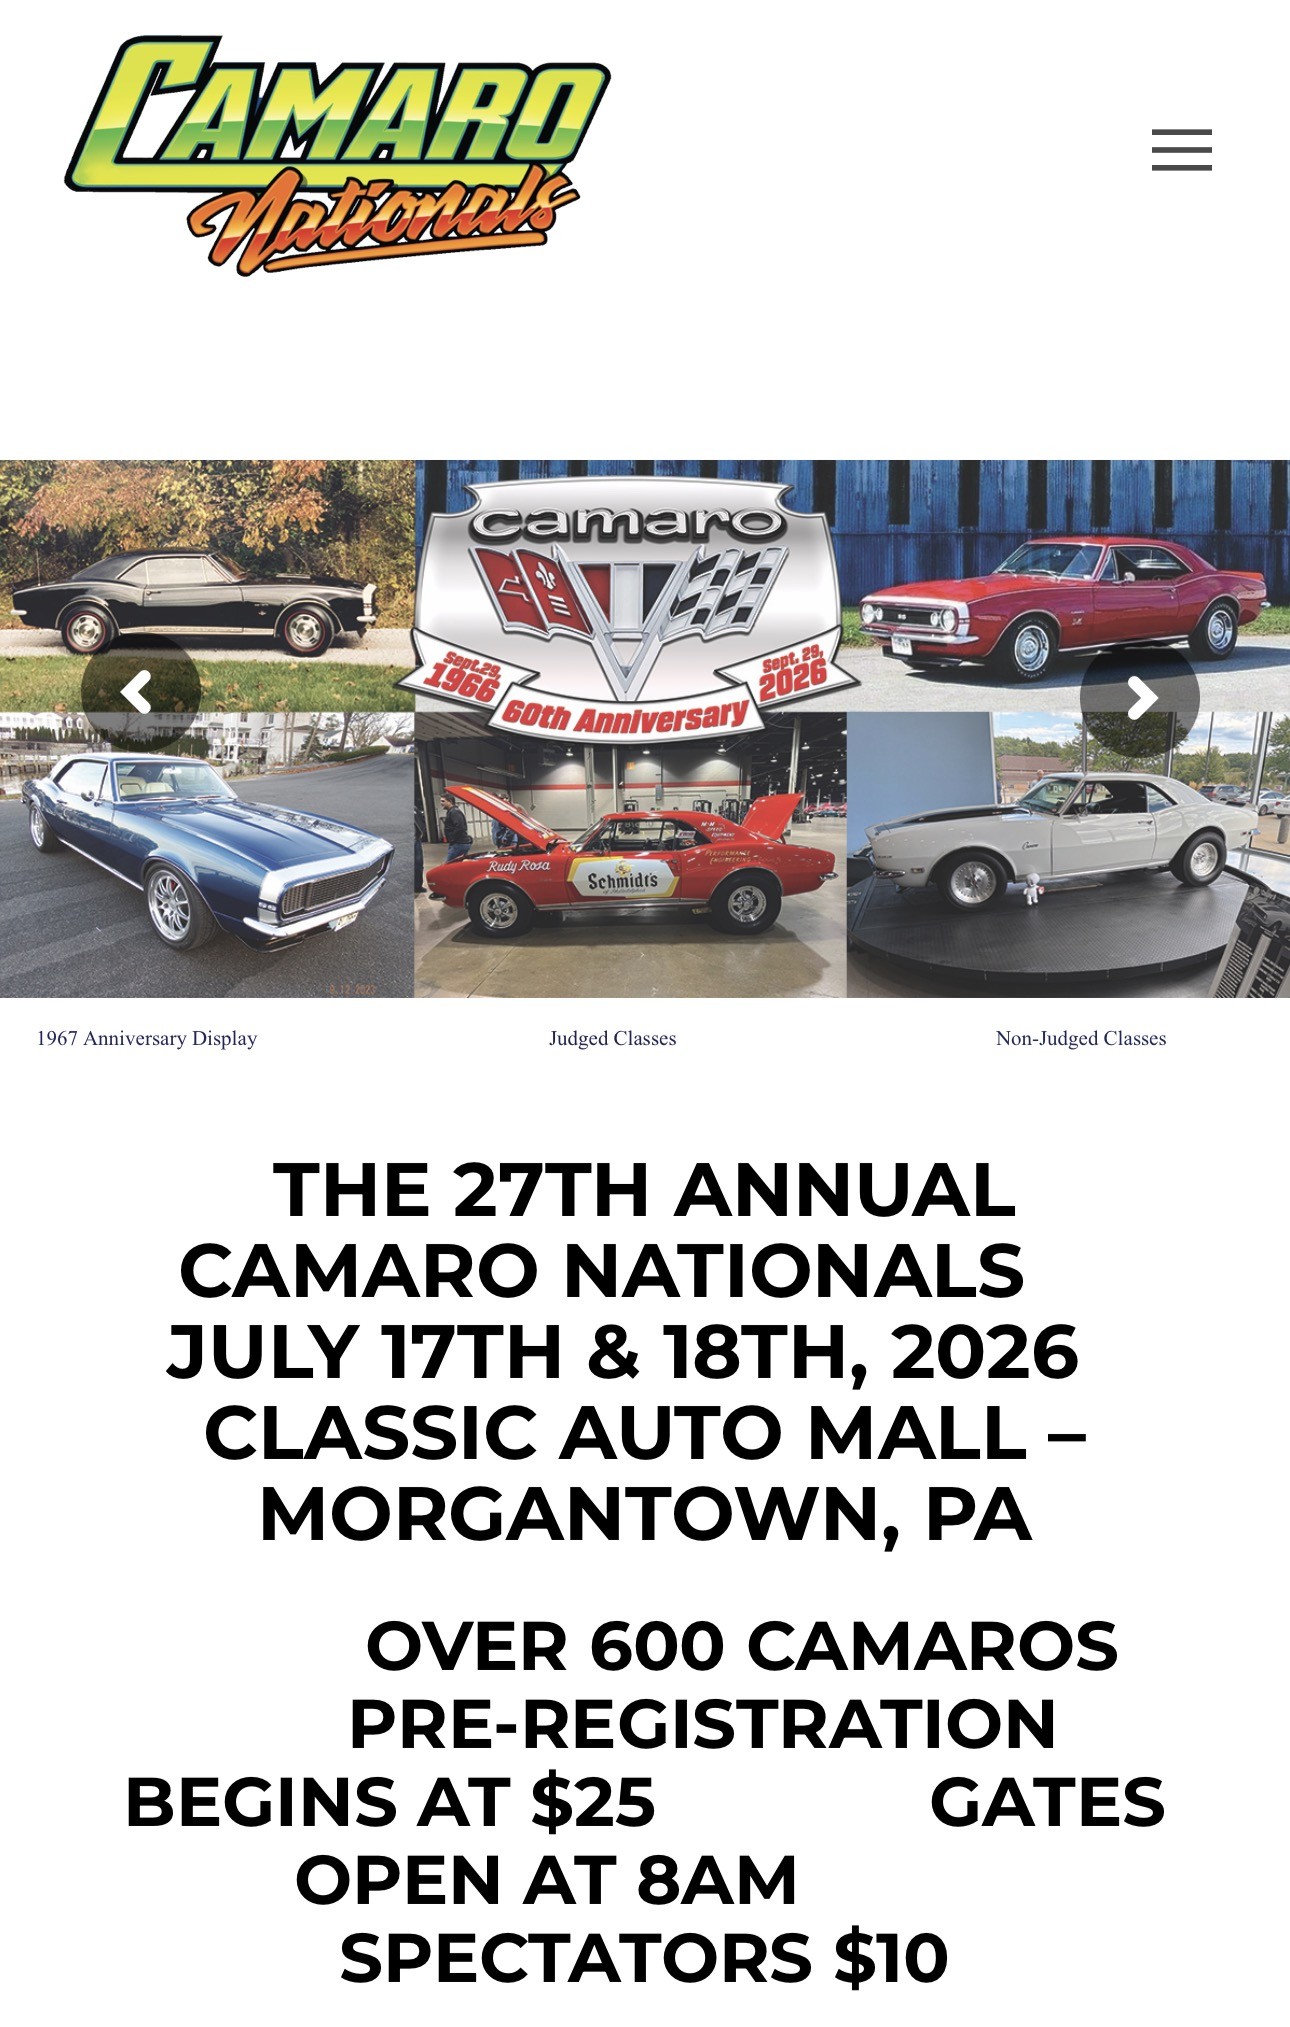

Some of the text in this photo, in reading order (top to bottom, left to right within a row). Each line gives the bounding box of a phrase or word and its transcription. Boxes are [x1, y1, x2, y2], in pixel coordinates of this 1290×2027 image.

[64, 35, 612, 192] CAMARO
[186, 164, 581, 276] Nationals
[469, 506, 788, 544] camaro
[423, 662, 501, 703] 1966
[759, 657, 827, 703] 2026
[762, 643, 824, 674] Sept. 29,
[501, 699, 750, 734] 60th Anniversary
[486, 859, 551, 874] Rudy Rosa
[588, 871, 658, 890] Schmidt's
[38, 1029, 258, 1051] 1967 Anniversary Display
[549, 1029, 677, 1051] Judged Classes
[995, 1029, 1167, 1051] Non-Judged Classes
[272, 1161, 1016, 1218] THE 27TH ANNUAL
[180, 1242, 1024, 1299] CAMARO NATIONALS
[165, 1323, 1079, 1391] JULY 17TH & 18TH, 2026
[205, 1404, 537, 1461] CLASSIC
[557, 1404, 782, 1461] AUTO
[810, 1405, 1027, 1460] MALL
[262, 1485, 1034, 1553] MORGANTOWN, PA
[367, 1620, 1118, 1672] OVER 600 CAMAROS
[352, 1698, 1054, 1750] PRE-REGISTRATION
[128, 1768, 1165, 1835] BEGINS AT $25 GATES
[296, 1854, 795, 1906] OPEN AT 8AM
[340, 1924, 948, 1991] SPECTATORS $10
